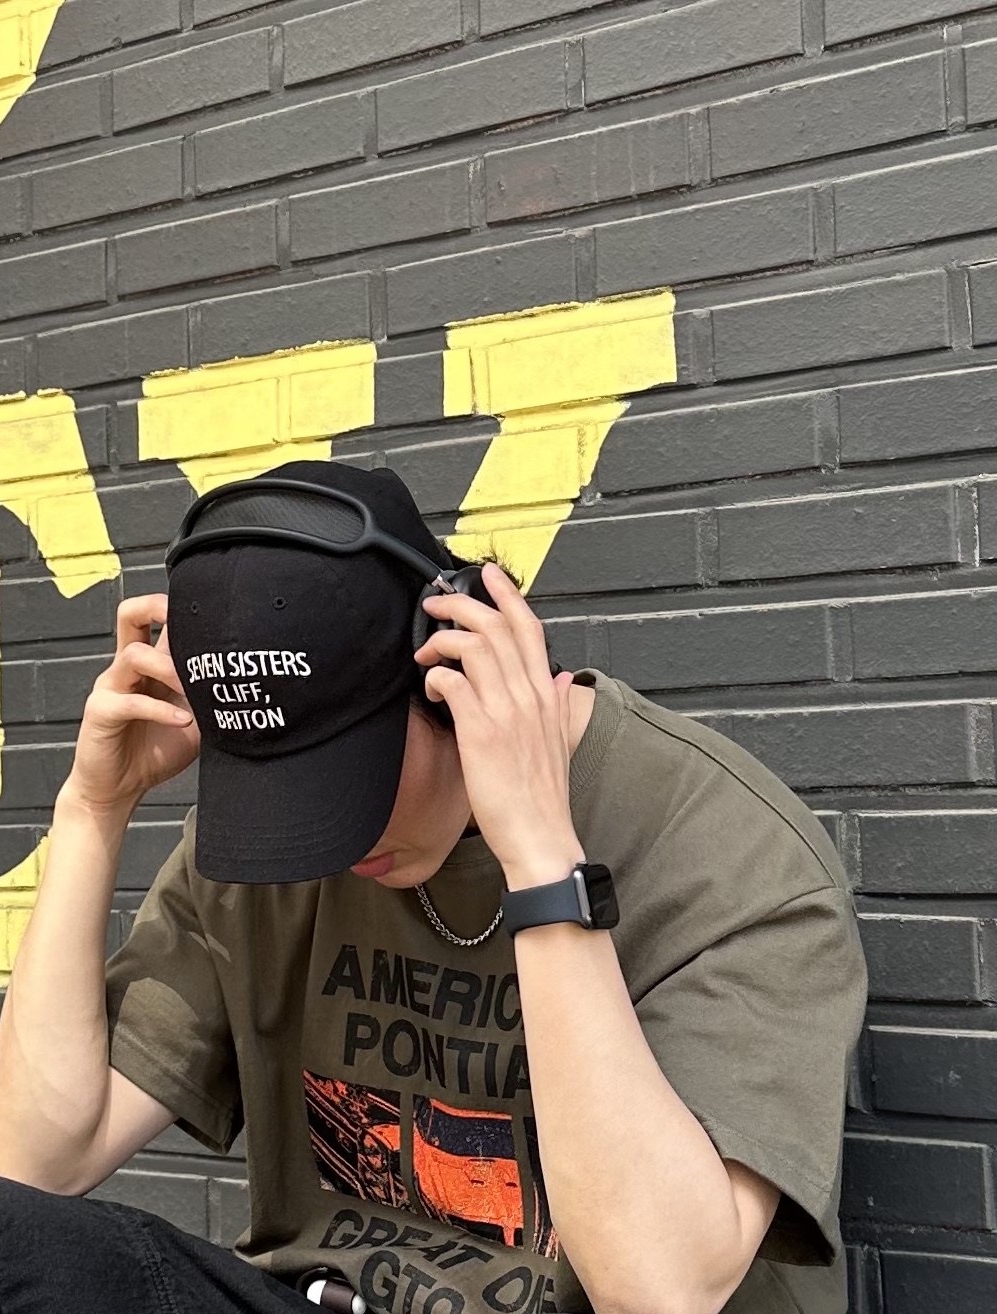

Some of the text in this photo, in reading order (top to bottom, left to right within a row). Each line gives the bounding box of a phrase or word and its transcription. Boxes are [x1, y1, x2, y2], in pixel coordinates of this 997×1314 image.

[186, 650, 312, 684] SEVEN SISTERS
[212, 681, 271, 704] CLIFF,
[213, 706, 286, 731] BRITON
[321, 943, 525, 1032] AMERIC
